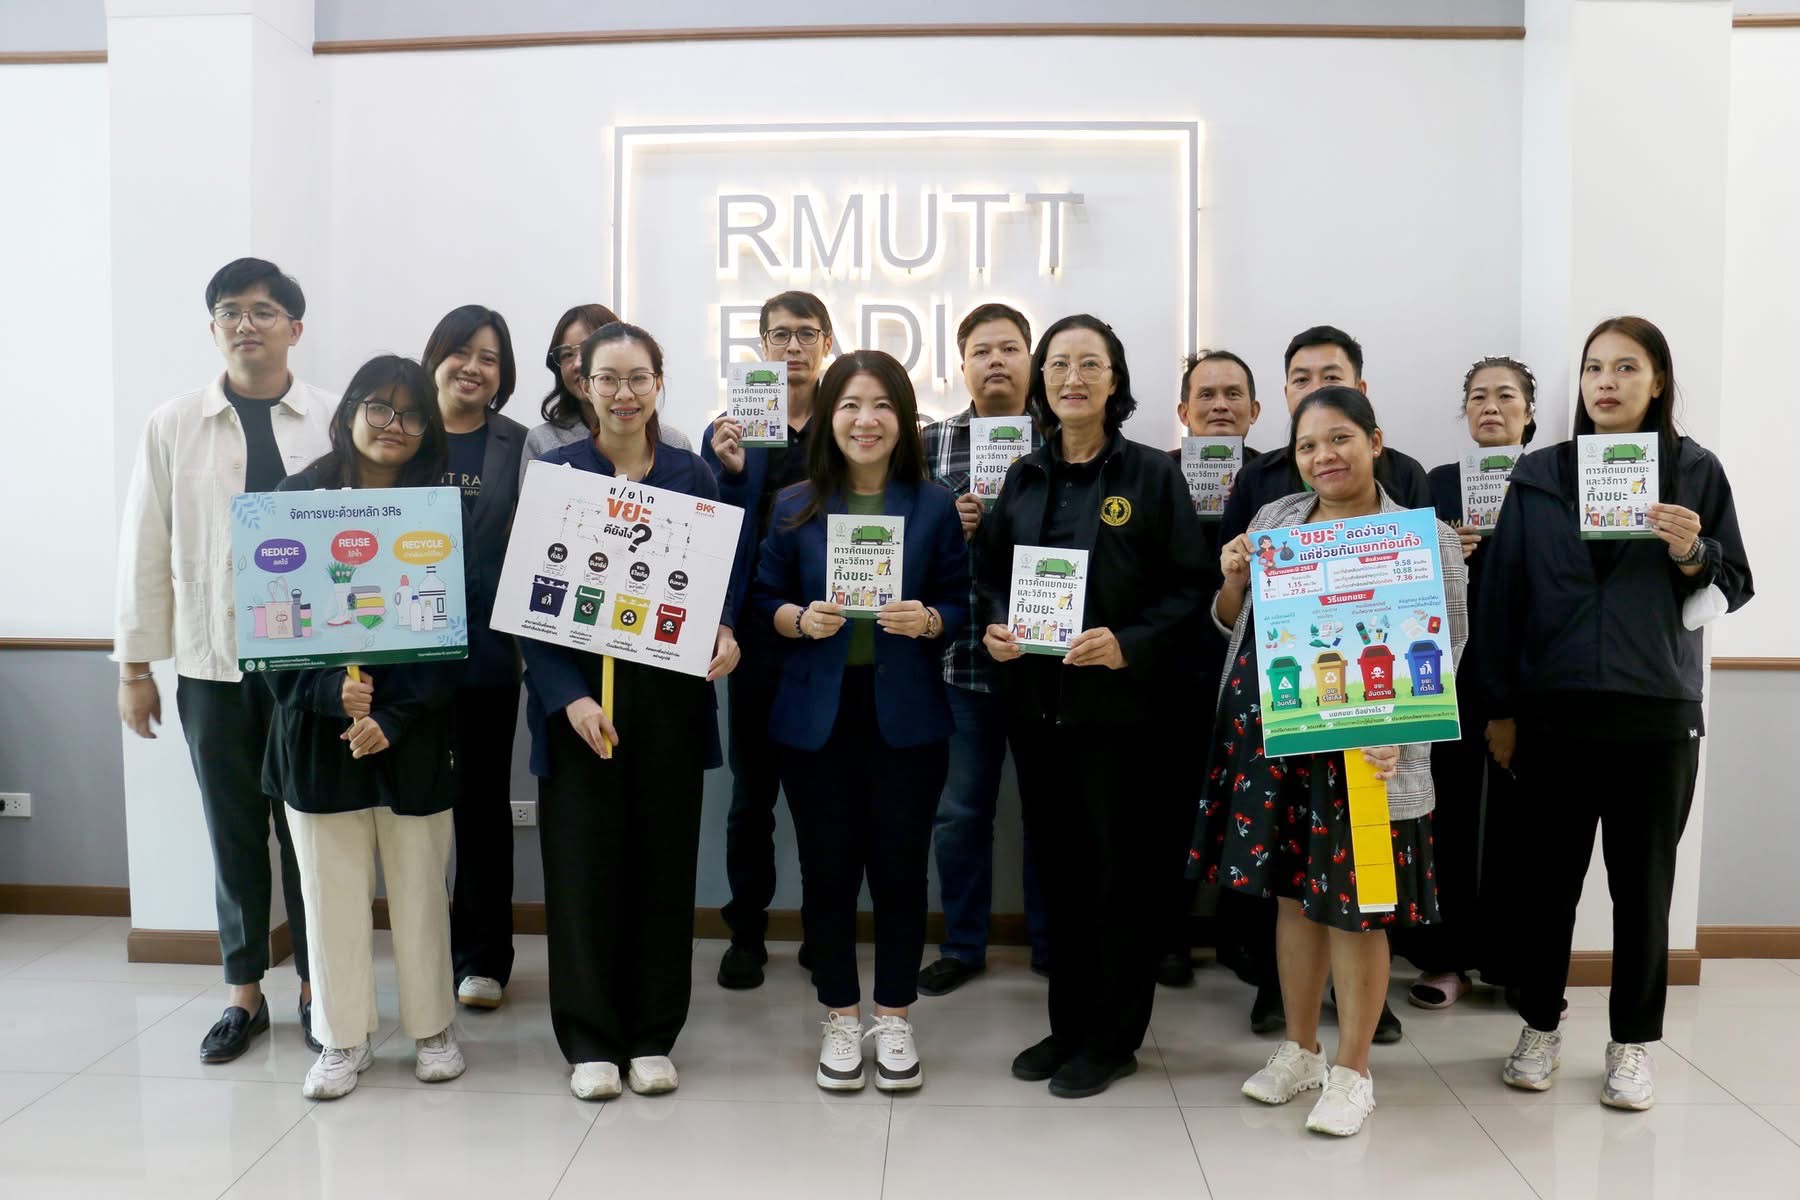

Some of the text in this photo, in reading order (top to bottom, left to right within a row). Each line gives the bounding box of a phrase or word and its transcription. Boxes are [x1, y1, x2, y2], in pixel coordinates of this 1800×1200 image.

[718, 193, 1085, 269] RMUTT
[732, 404, 765, 416] ทิ้งขยะ
[1585, 464, 1649, 475] การคัดแยกขยะ
[1468, 492, 1503, 505] ทิ้งขยะ
[1586, 486, 1629, 502] ทิ้งขยะ
[289, 506, 402, 520] จัดการขยะด้วยหลัก 3Rs
[607, 498, 652, 524] ขยะ
[695, 502, 716, 514] BKK
[338, 538, 371, 548] REUSE
[402, 539, 443, 549] RECYCLE
[261, 547, 300, 557] REDUCE
[834, 545, 895, 555] การคัดแยกขยะ
[834, 565, 874, 581] ทิ้งขยะ
[1393, 567, 1412, 575] 10.88
[1018, 577, 1078, 590] การคัดแยกขยะ
[1288, 581, 1302, 589] 1.15
[1290, 588, 1306, 596] 27.8
[1016, 598, 1055, 615] ทิ้งขยะ
